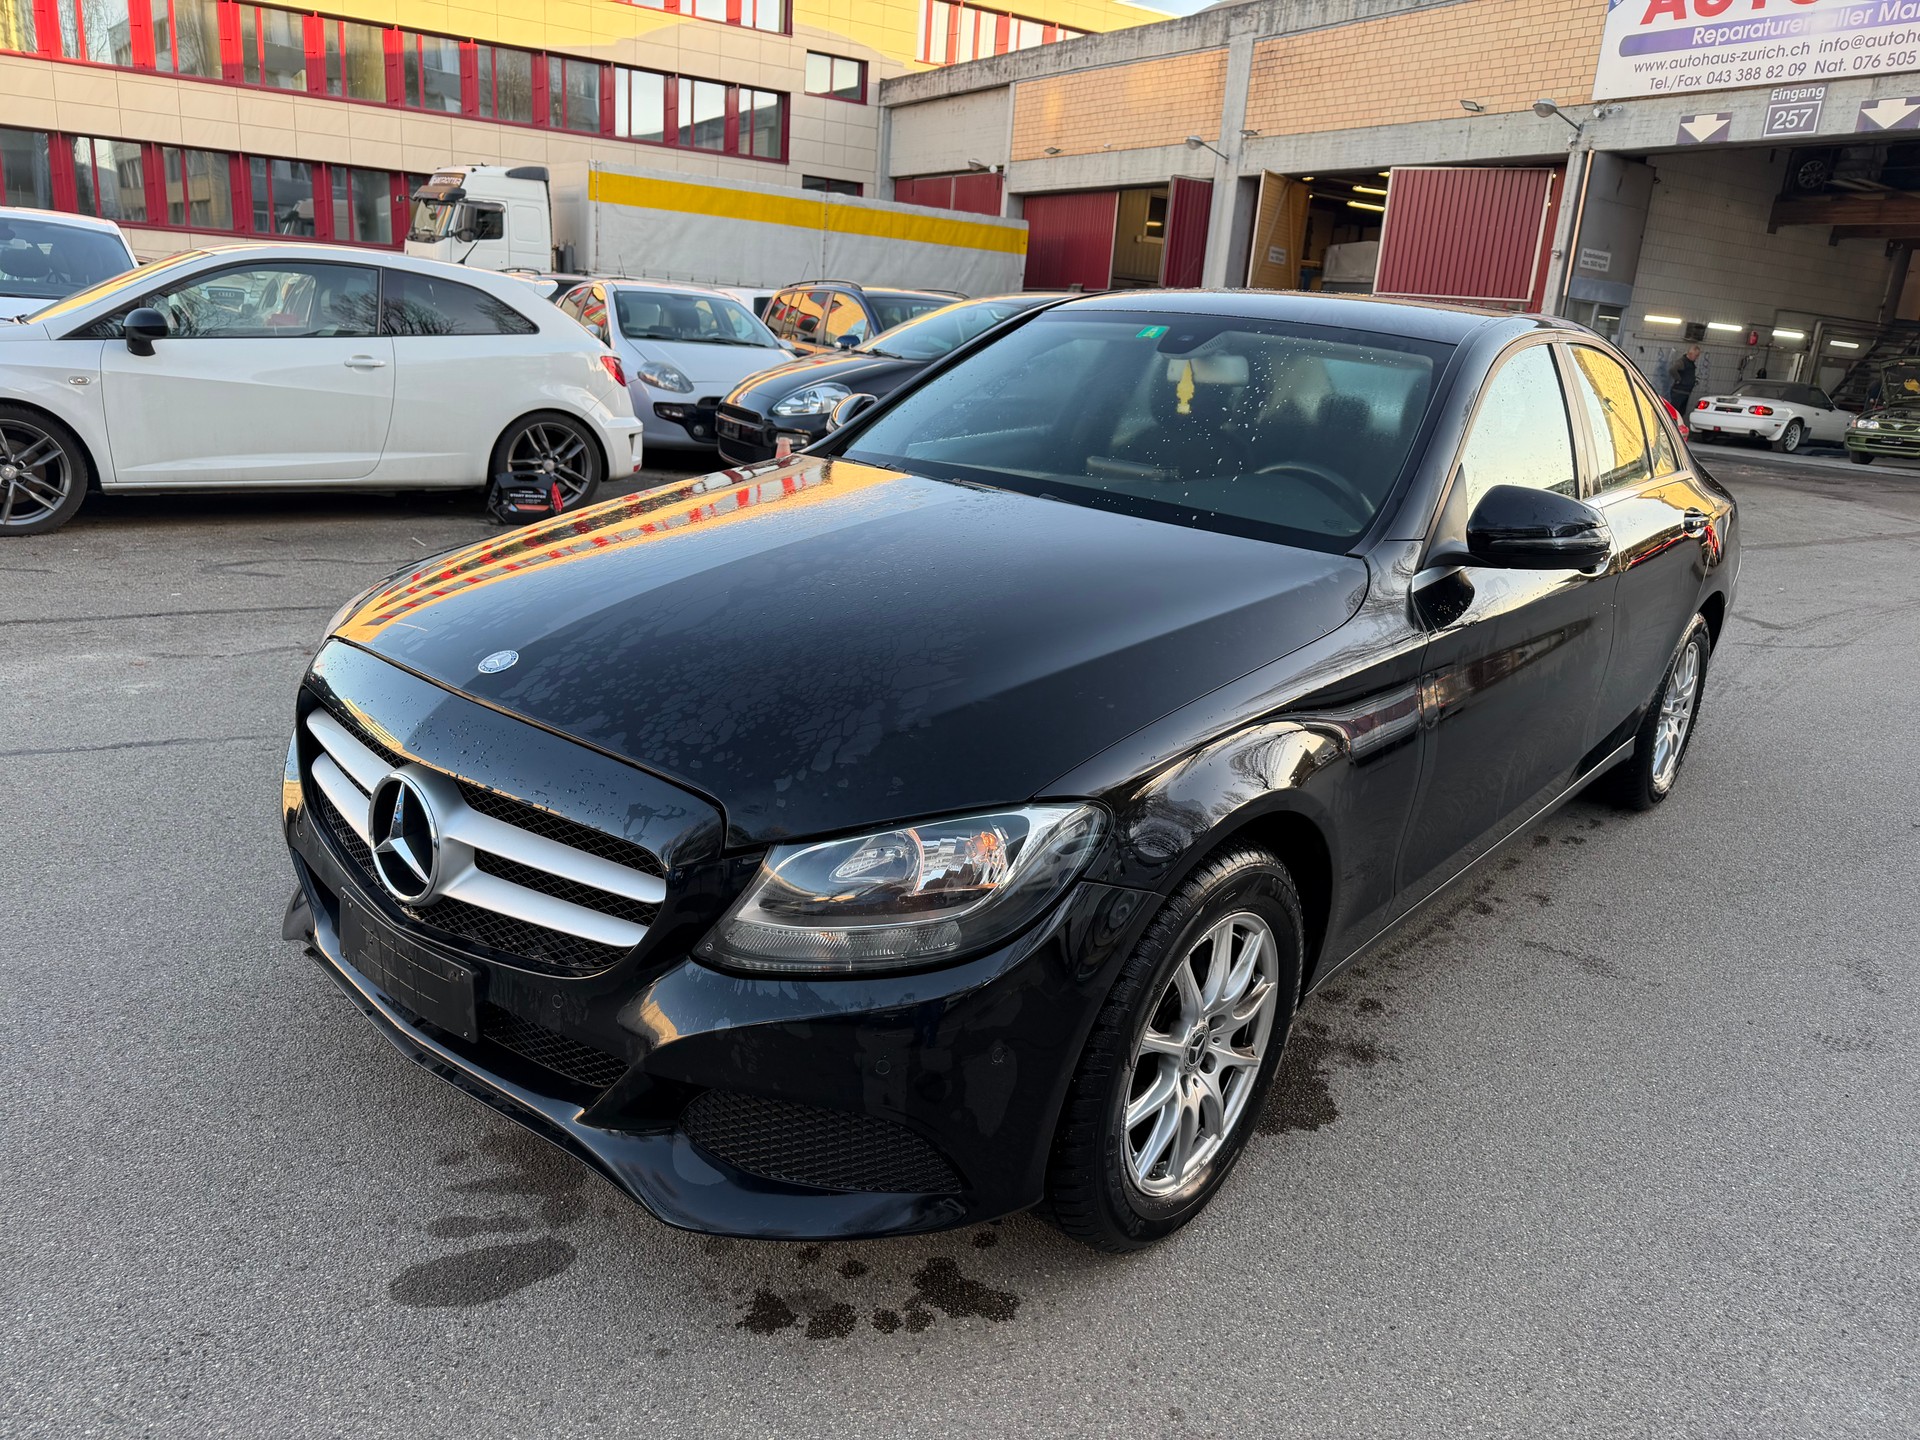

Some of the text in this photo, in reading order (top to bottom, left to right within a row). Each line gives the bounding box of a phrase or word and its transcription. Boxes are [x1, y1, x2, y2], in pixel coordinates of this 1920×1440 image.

[1634, 42, 1810, 73] www.autohaus-zurich.ch
[1650, 50, 1917, 91] Tel./Fax 043 388 82 09 Nat. 076 505
[1771, 86, 1825, 102] Eingang
[1772, 108, 1813, 129] 257
